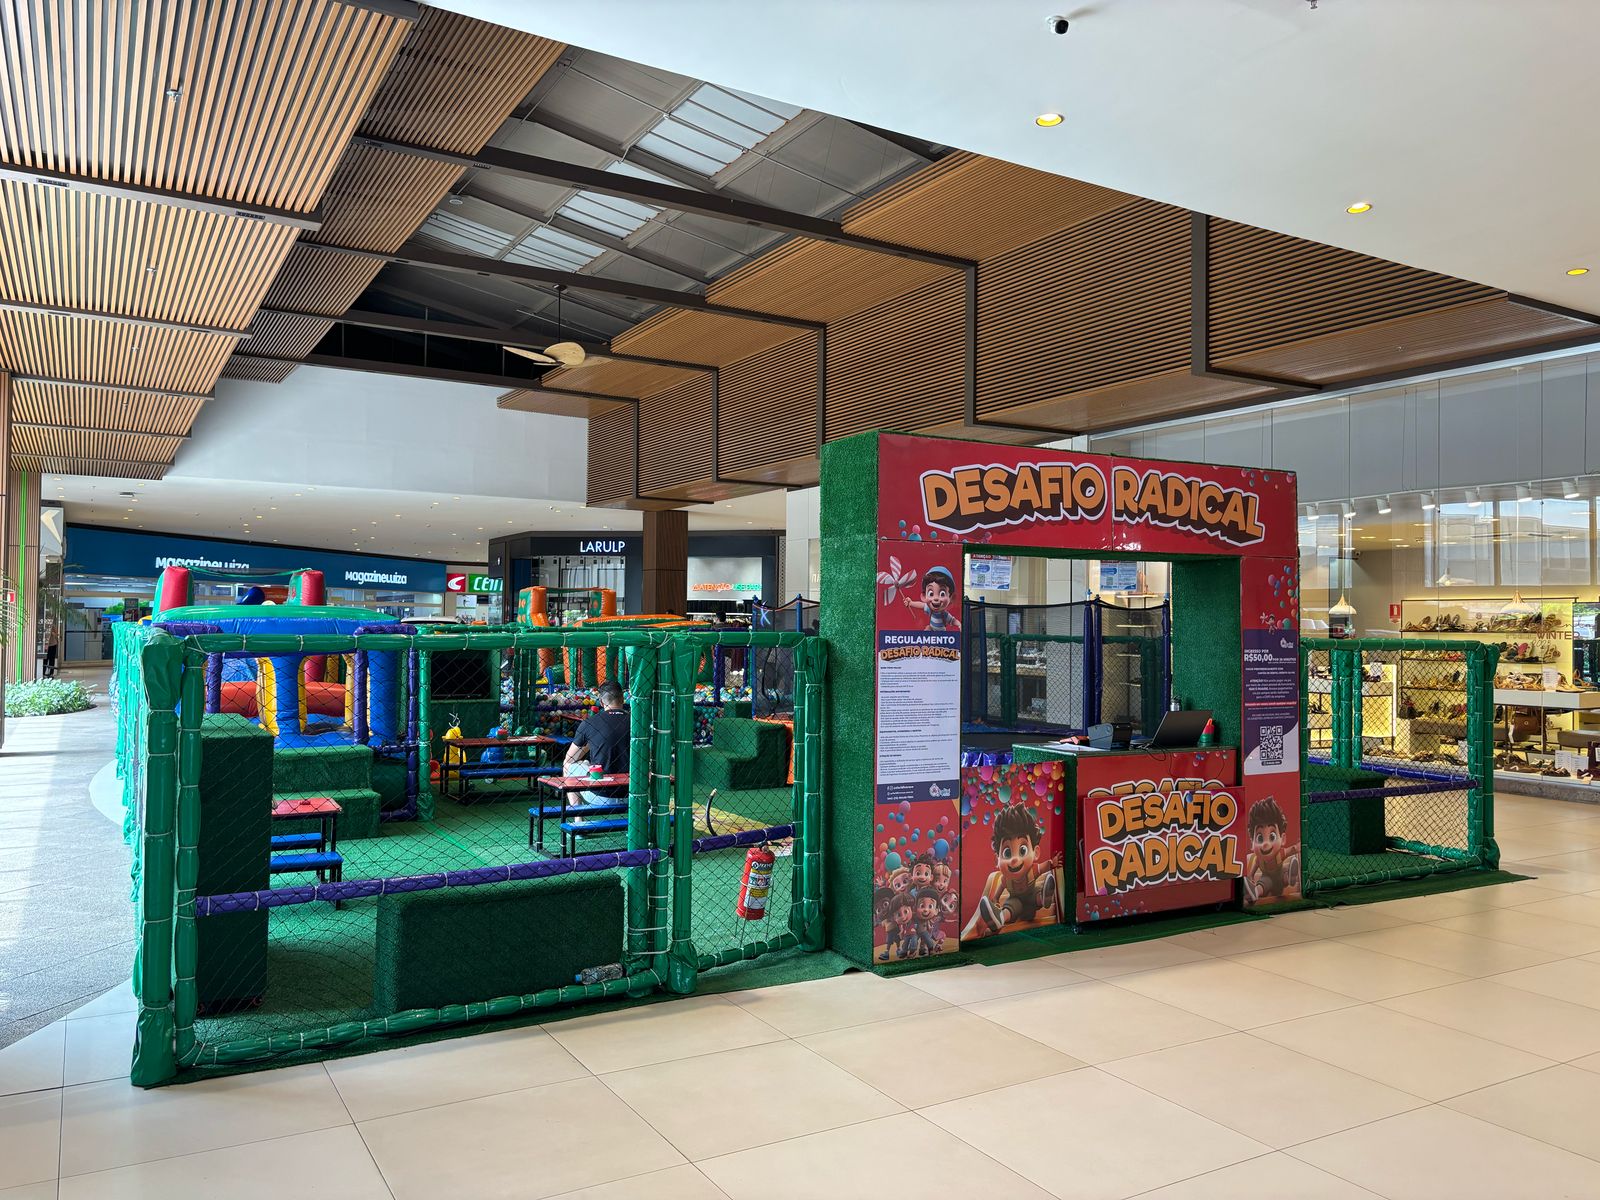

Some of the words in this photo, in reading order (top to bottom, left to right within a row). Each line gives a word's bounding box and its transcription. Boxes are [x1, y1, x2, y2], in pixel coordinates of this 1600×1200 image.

[921, 463, 1107, 529] DESAFIO
[1113, 466, 1265, 542] RADICAL
[579, 540, 626, 553] LARULP
[884, 635, 955, 645] REGULAMENTO
[880, 646, 921, 661] DESAFIO
[922, 645, 960, 661] RADICAL
[1244, 653, 1273, 662] R$50,00
[1098, 791, 1237, 843] DESAFIO
[1090, 833, 1244, 894] RADICAL
